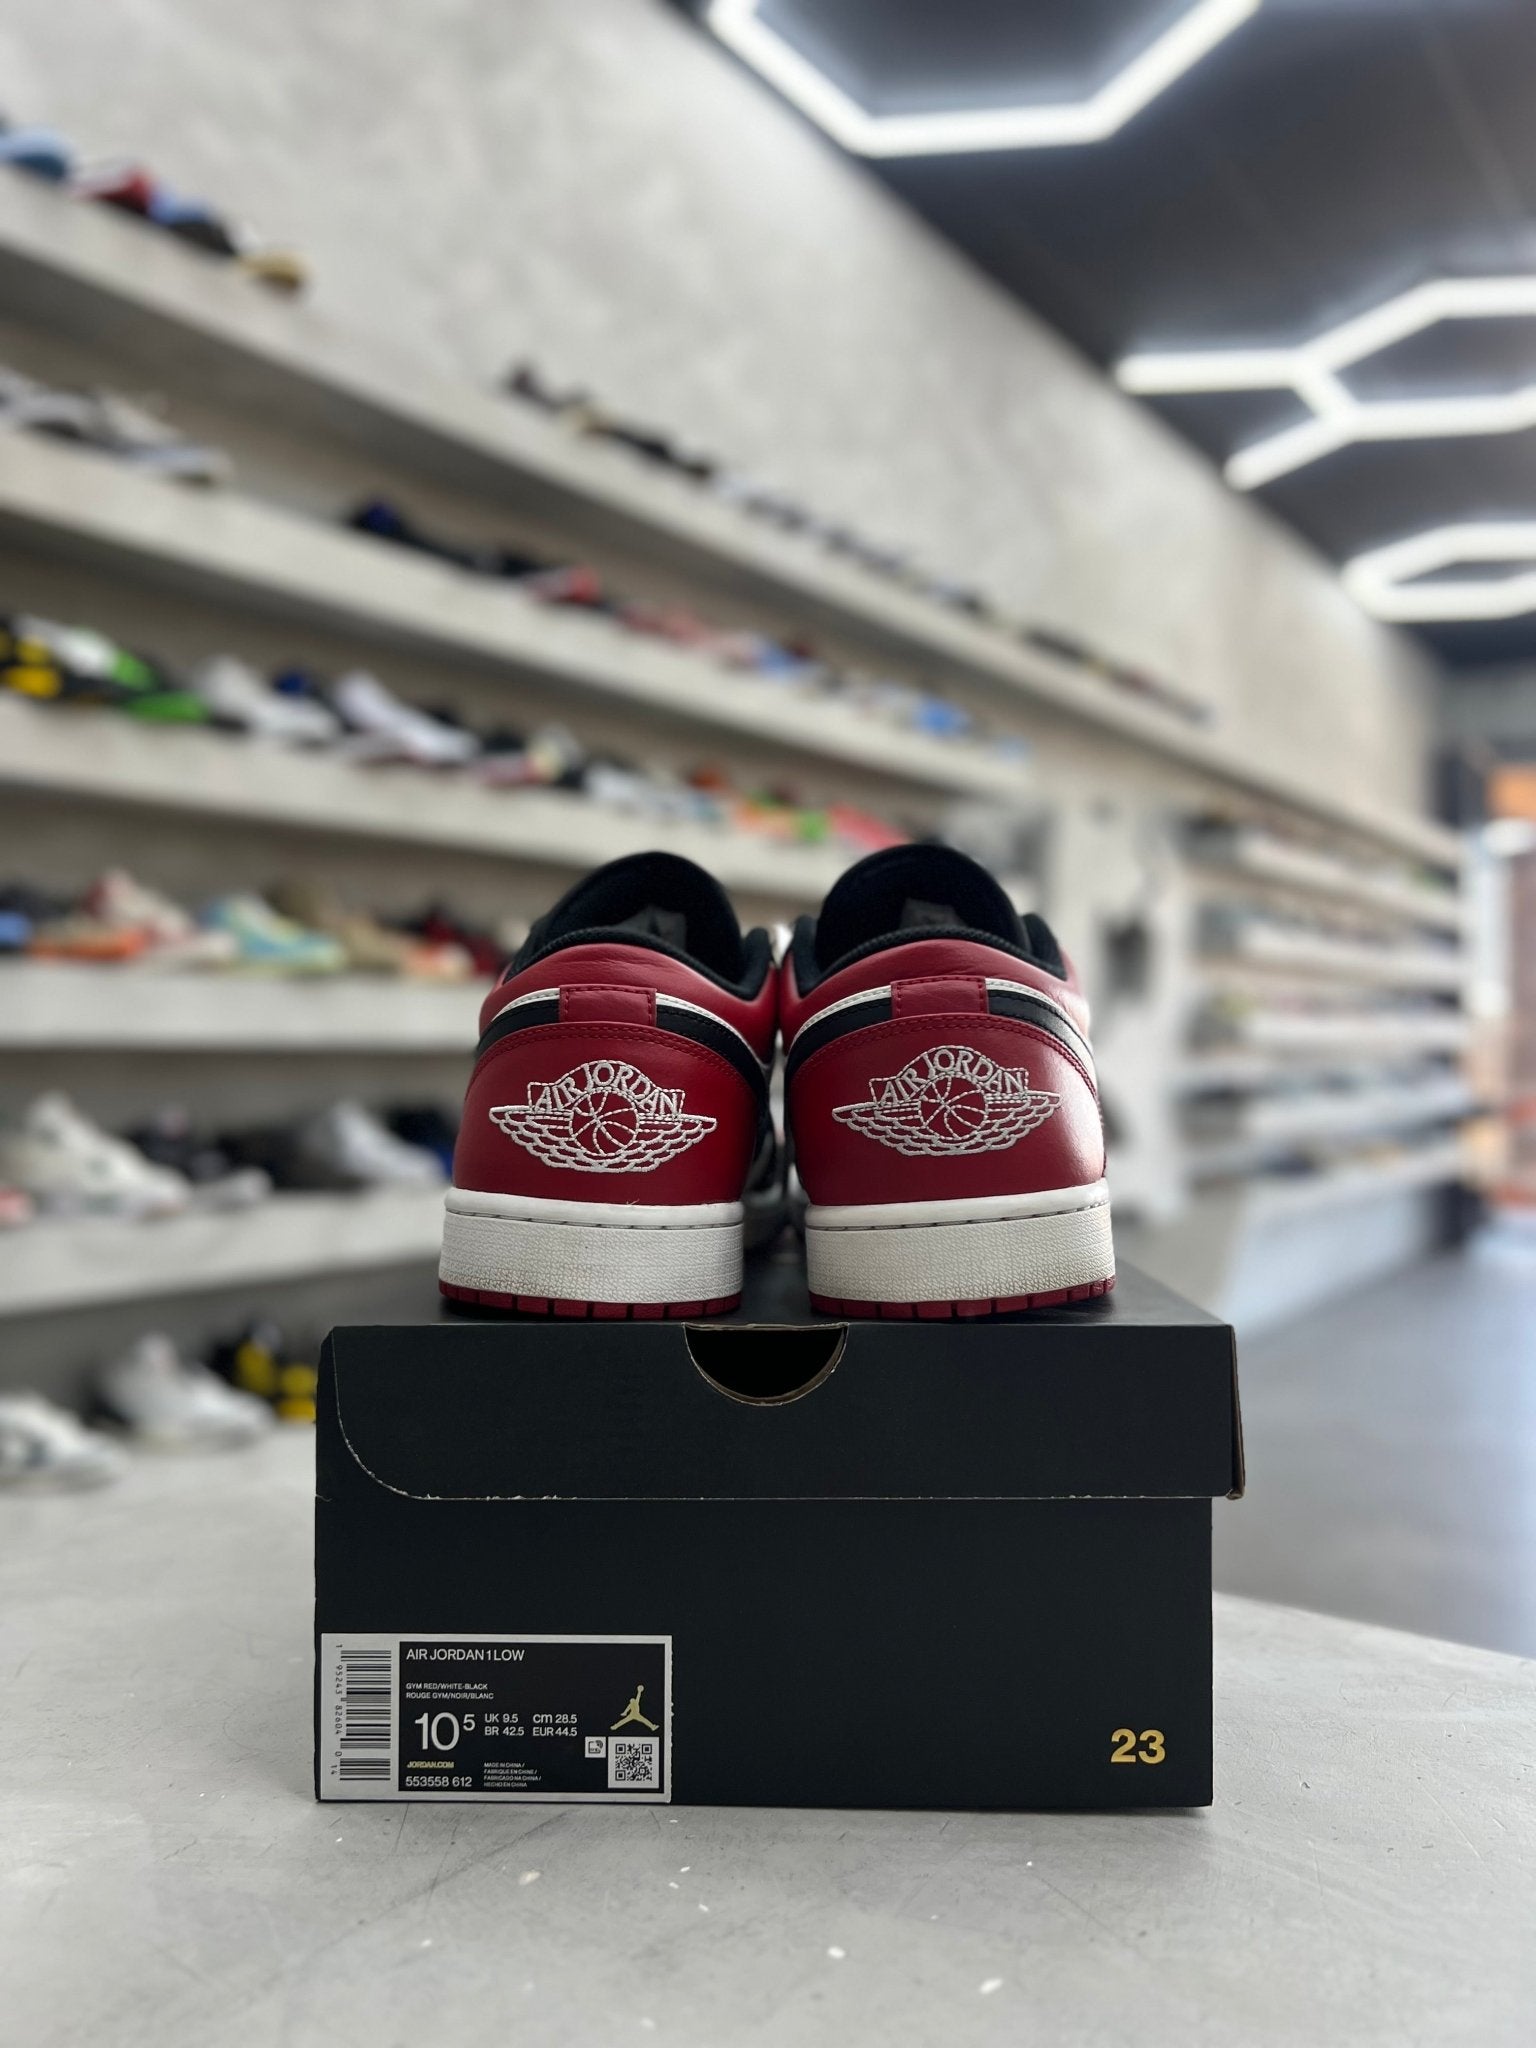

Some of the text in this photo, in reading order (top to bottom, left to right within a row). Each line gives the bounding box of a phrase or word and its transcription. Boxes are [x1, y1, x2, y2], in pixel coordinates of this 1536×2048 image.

[874, 1048, 1028, 1107] AIR JORDAN
[532, 1060, 682, 1118] AIR JORDAN
[406, 1648, 525, 1661] AIR JORDAN 1 LOW
[335, 1664, 343, 1695] 95243
[405, 1682, 488, 1690] GYM RED/WHITE-BLACK
[405, 1692, 494, 1700] ROUGE GYM/NOIR/BLANC
[334, 1705, 343, 1735] 82604
[484, 1713, 519, 1724] UK 9.5
[555, 1713, 578, 1724] 28.5
[484, 1726, 525, 1736] BR 42.5
[532, 1726, 578, 1737] EUR 44.5
[1110, 1728, 1166, 1765] 23
[406, 1761, 455, 1769] JORDAN.COM
[405, 1776, 473, 1787] 553558 612
